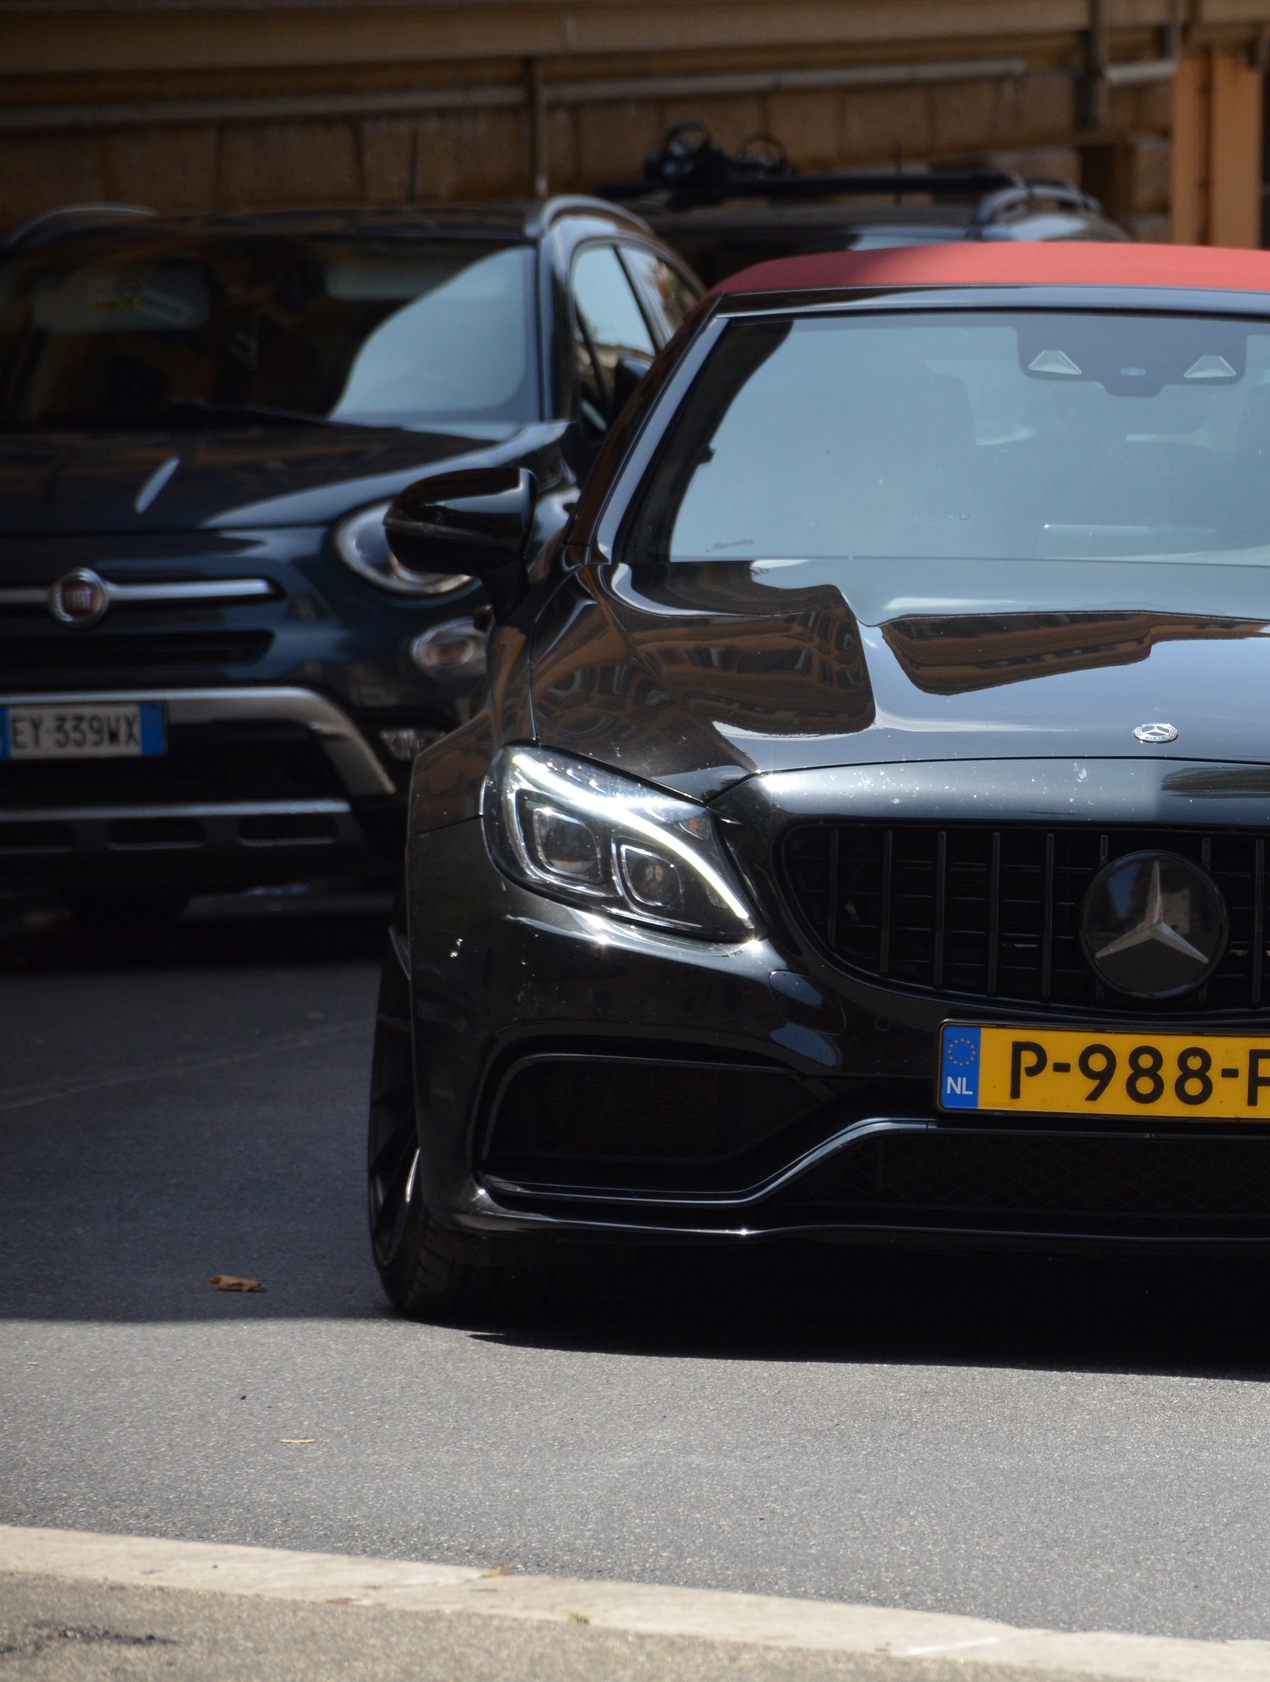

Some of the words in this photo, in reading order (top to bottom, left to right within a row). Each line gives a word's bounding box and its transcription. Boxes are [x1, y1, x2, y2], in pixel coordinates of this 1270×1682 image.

[11, 713, 44, 750] EY
[54, 713, 140, 748] 339WX
[946, 1076, 974, 1096] NL
